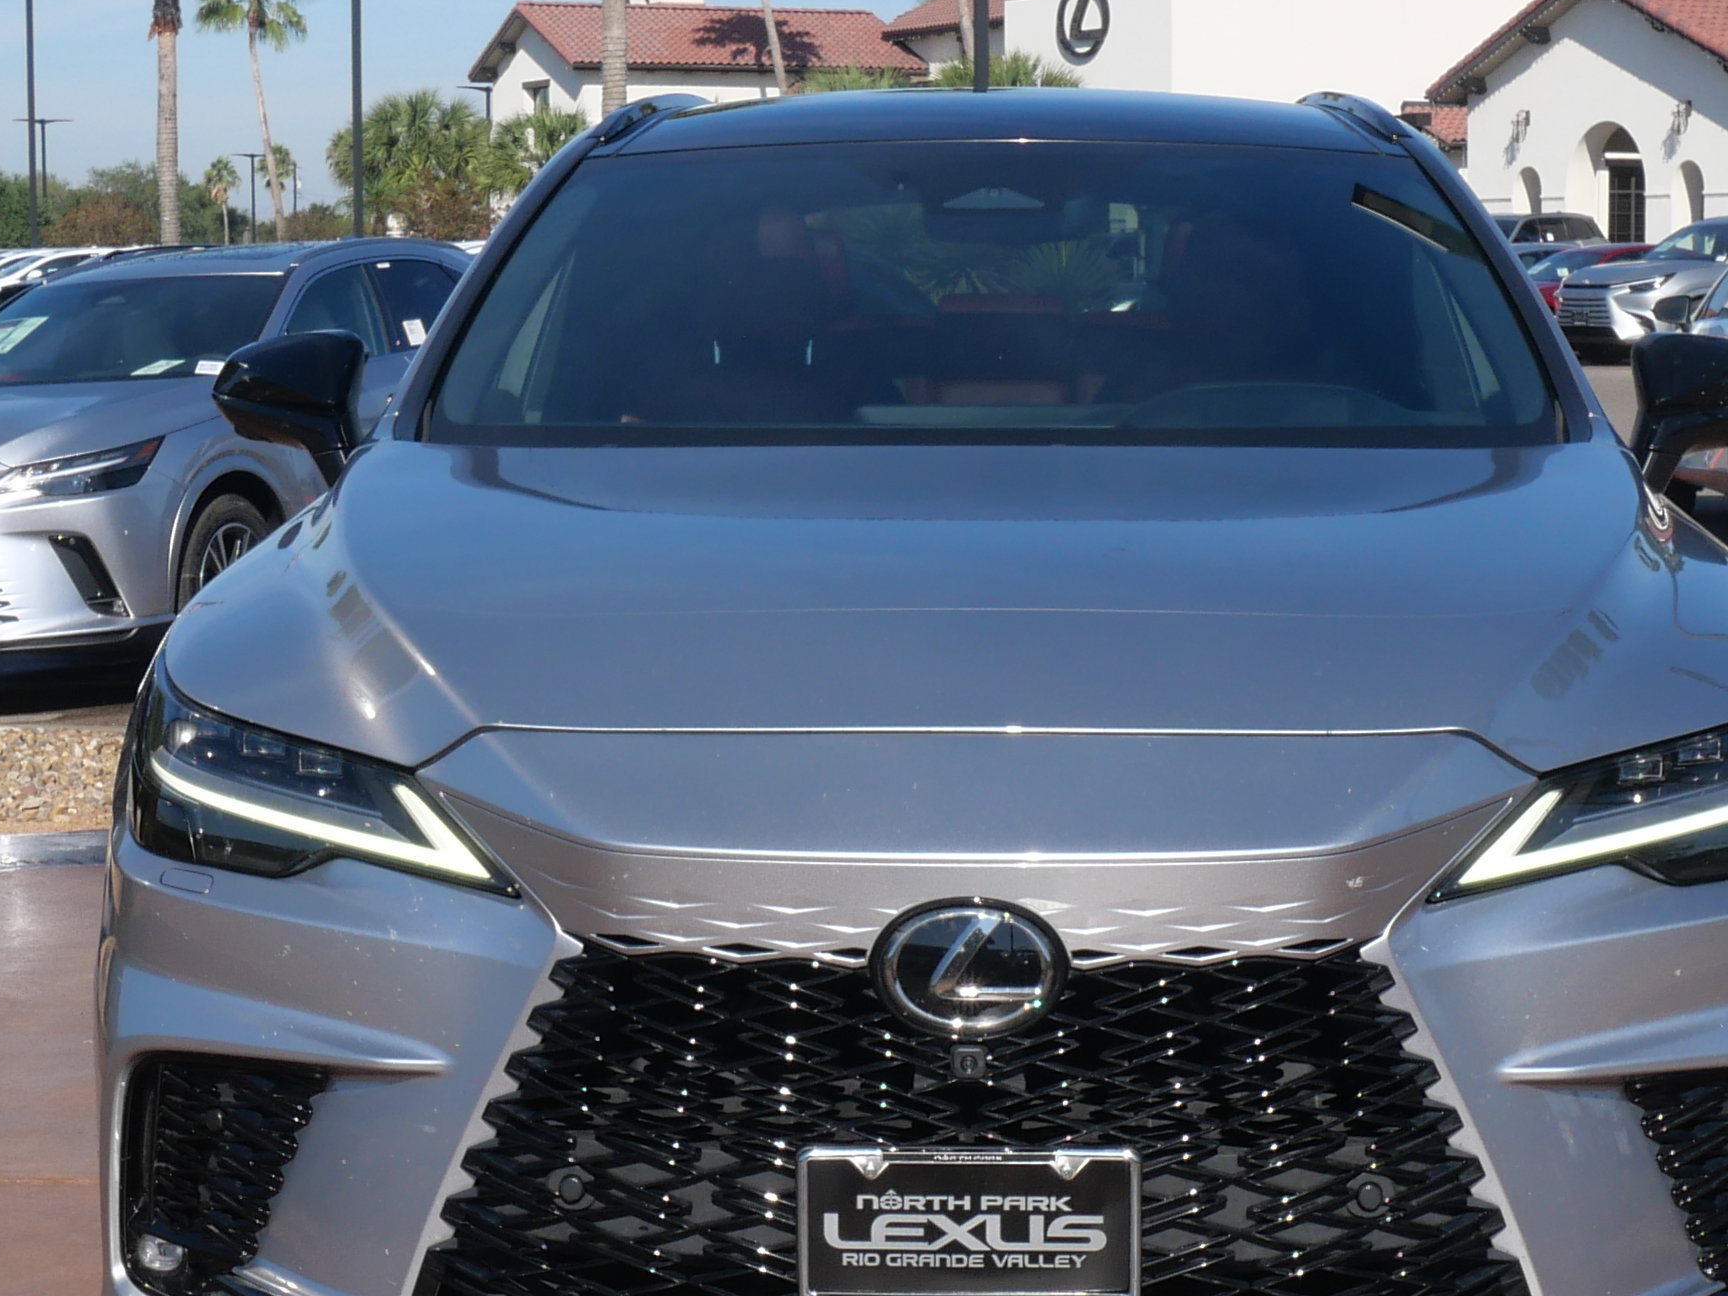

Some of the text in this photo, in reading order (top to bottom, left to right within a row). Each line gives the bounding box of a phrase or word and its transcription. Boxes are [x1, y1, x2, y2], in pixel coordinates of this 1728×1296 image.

[856, 1189, 1072, 1212] NORTH PARK
[823, 1212, 1108, 1252] LEXUS
[842, 1252, 1087, 1269] RIO GRANDE VALLEY
